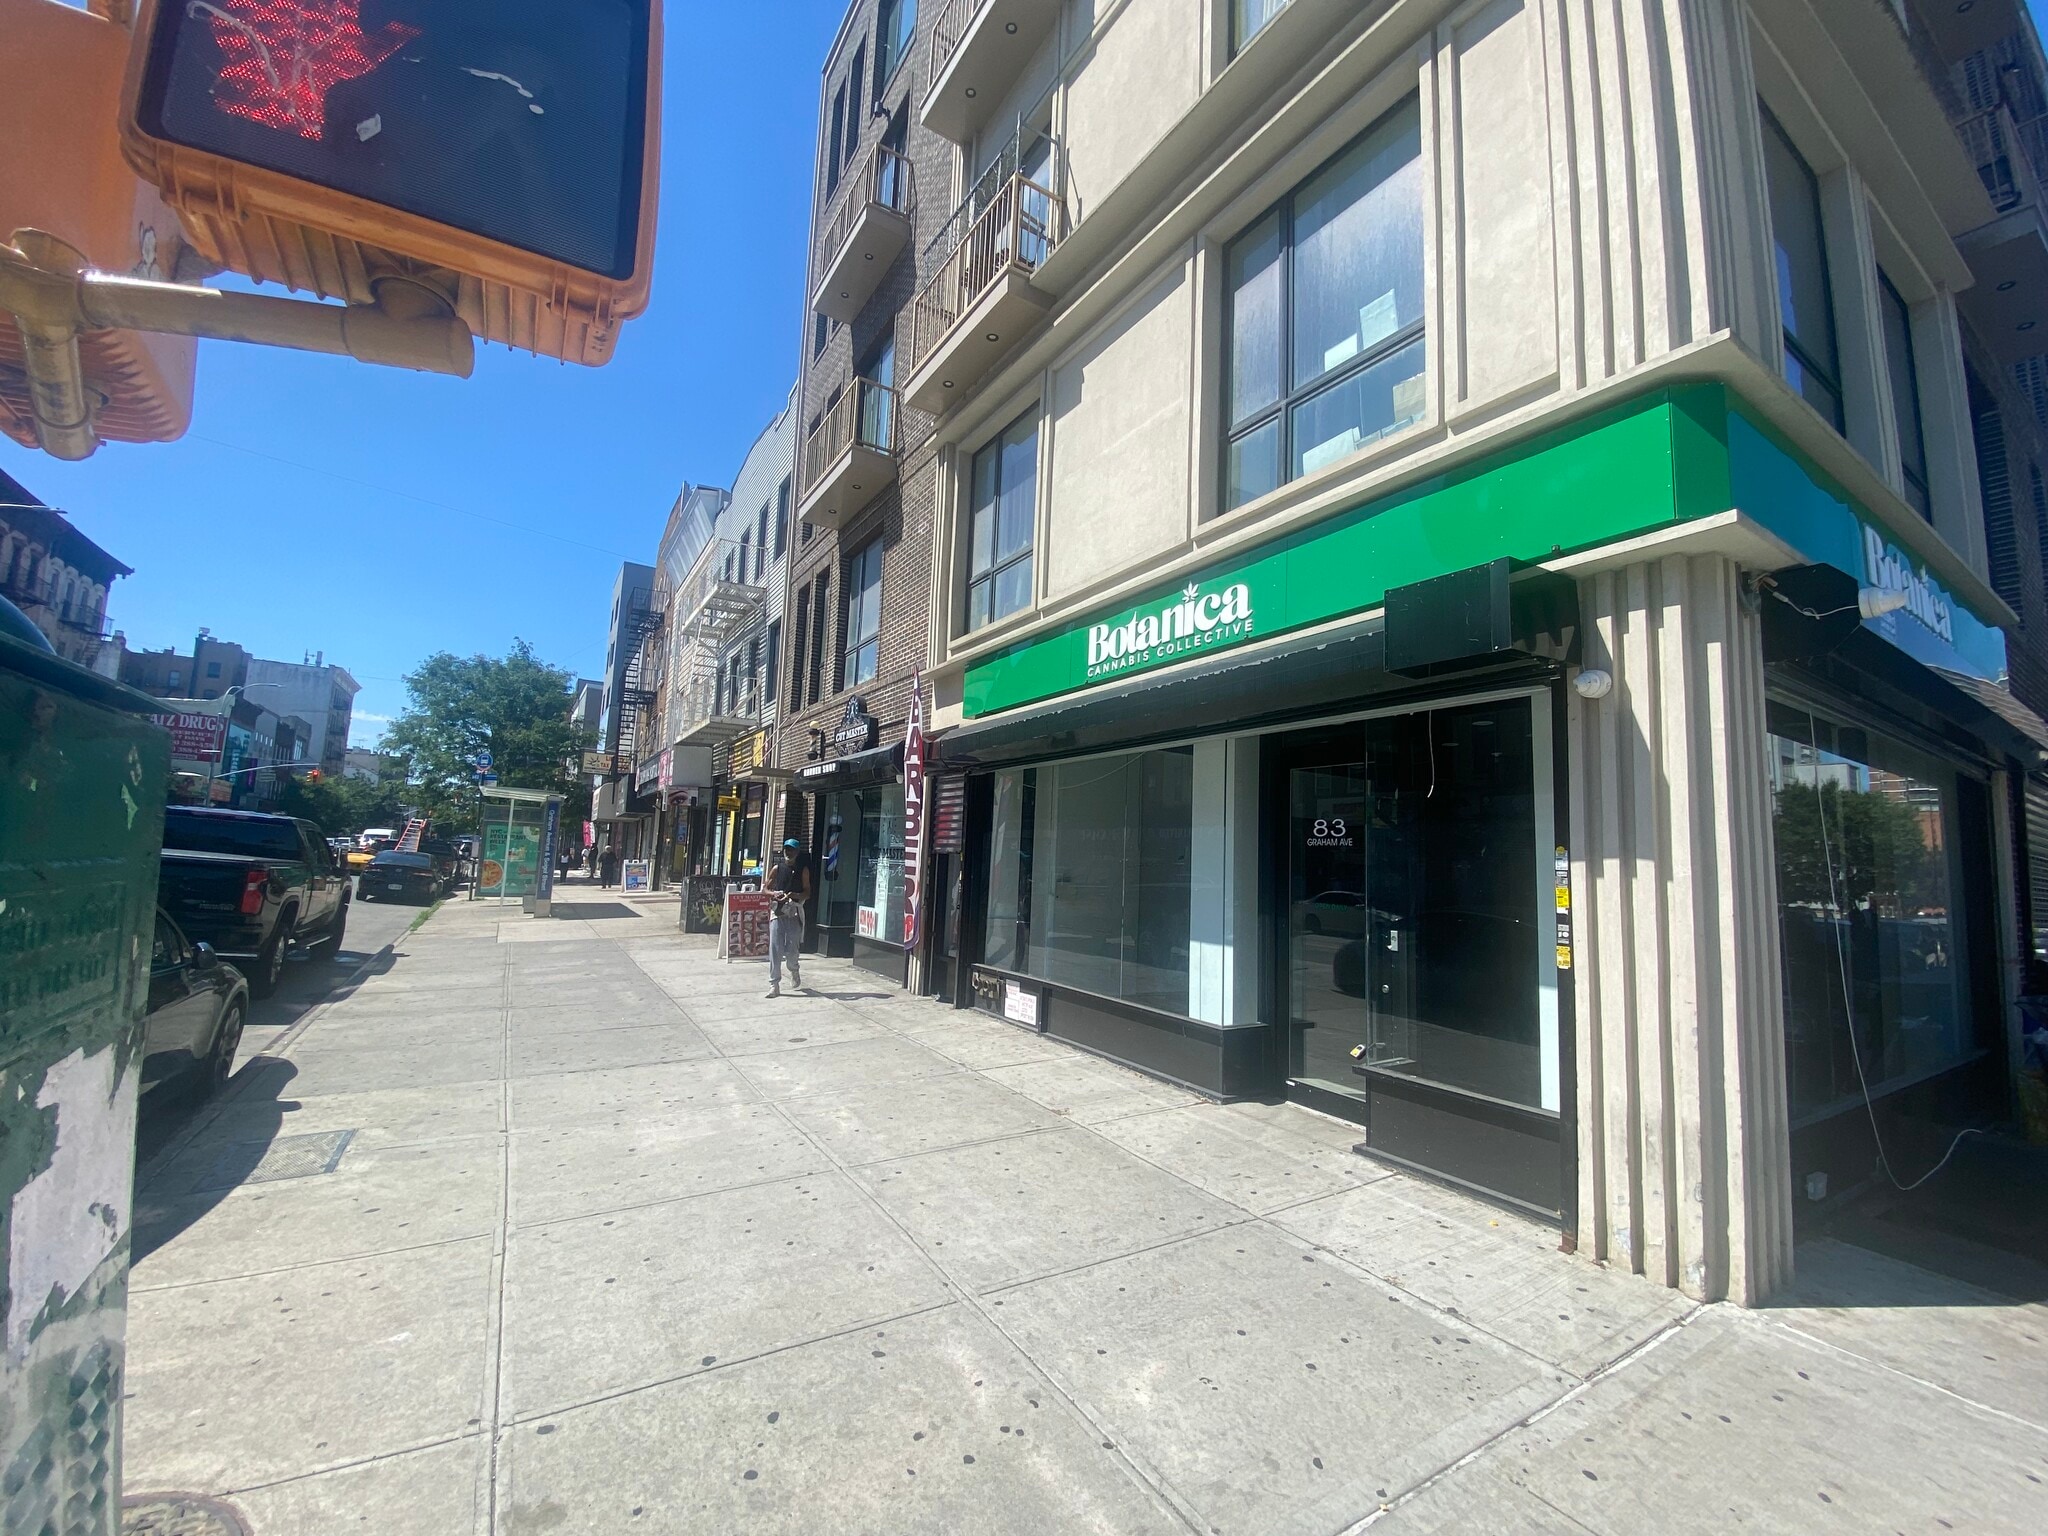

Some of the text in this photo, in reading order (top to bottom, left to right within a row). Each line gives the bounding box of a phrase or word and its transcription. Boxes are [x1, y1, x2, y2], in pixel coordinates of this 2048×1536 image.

[1087, 583, 1253, 667] Botanica
[1087, 619, 1254, 678] CANNABIS COLLECTIVE
[836, 724, 868, 742] CUT MASTER
[904, 693, 921, 914] BARBER
[1306, 837, 1353, 847] GRAHAM AVE
[1313, 818, 1347, 837] 83
